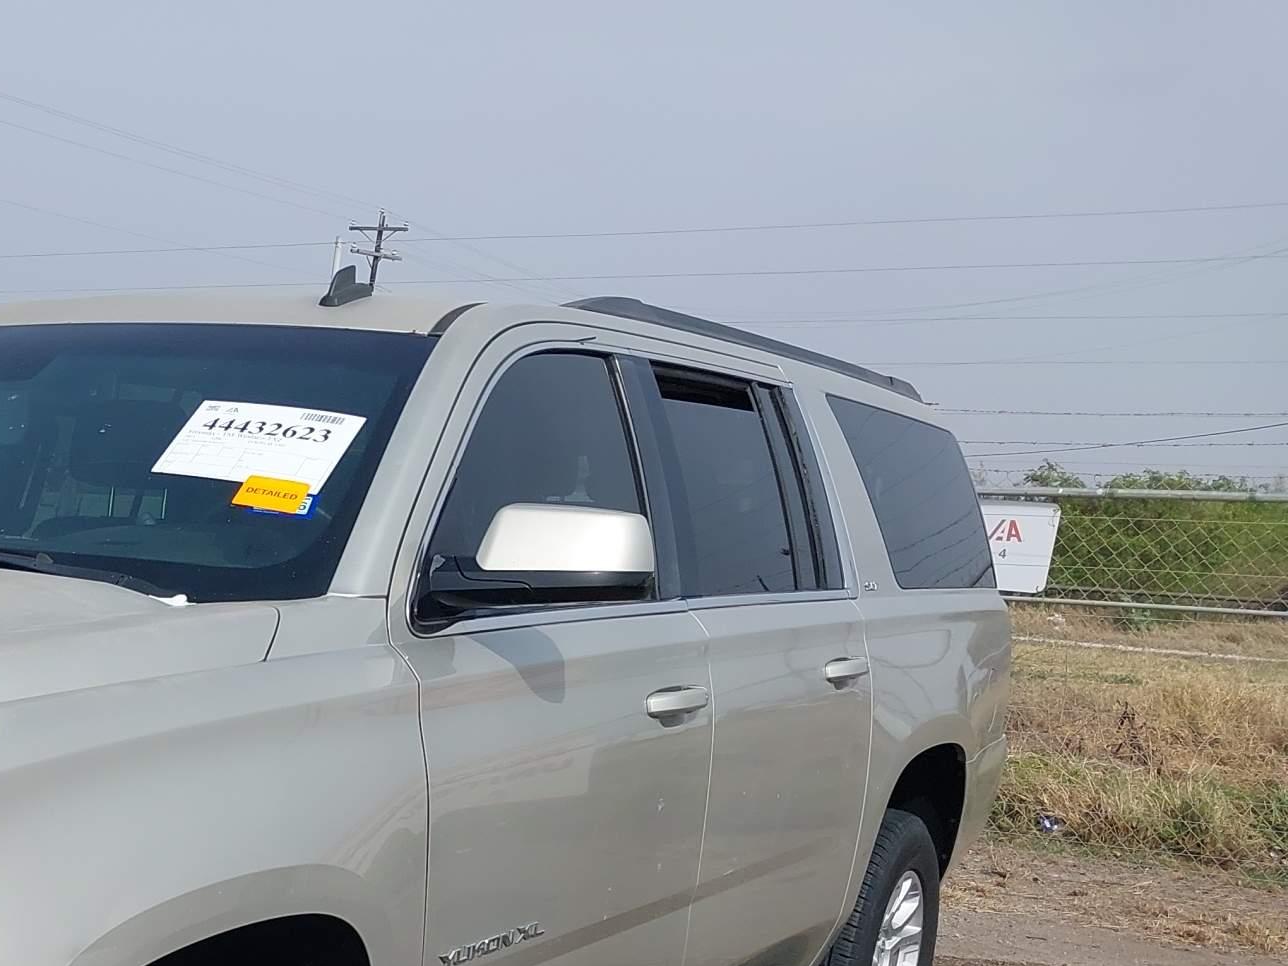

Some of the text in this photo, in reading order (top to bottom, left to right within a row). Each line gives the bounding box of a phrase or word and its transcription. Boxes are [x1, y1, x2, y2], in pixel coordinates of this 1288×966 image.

[203, 417, 332, 443] 44432623
[245, 486, 298, 501] DETAILED
[516, 921, 545, 944] XL
